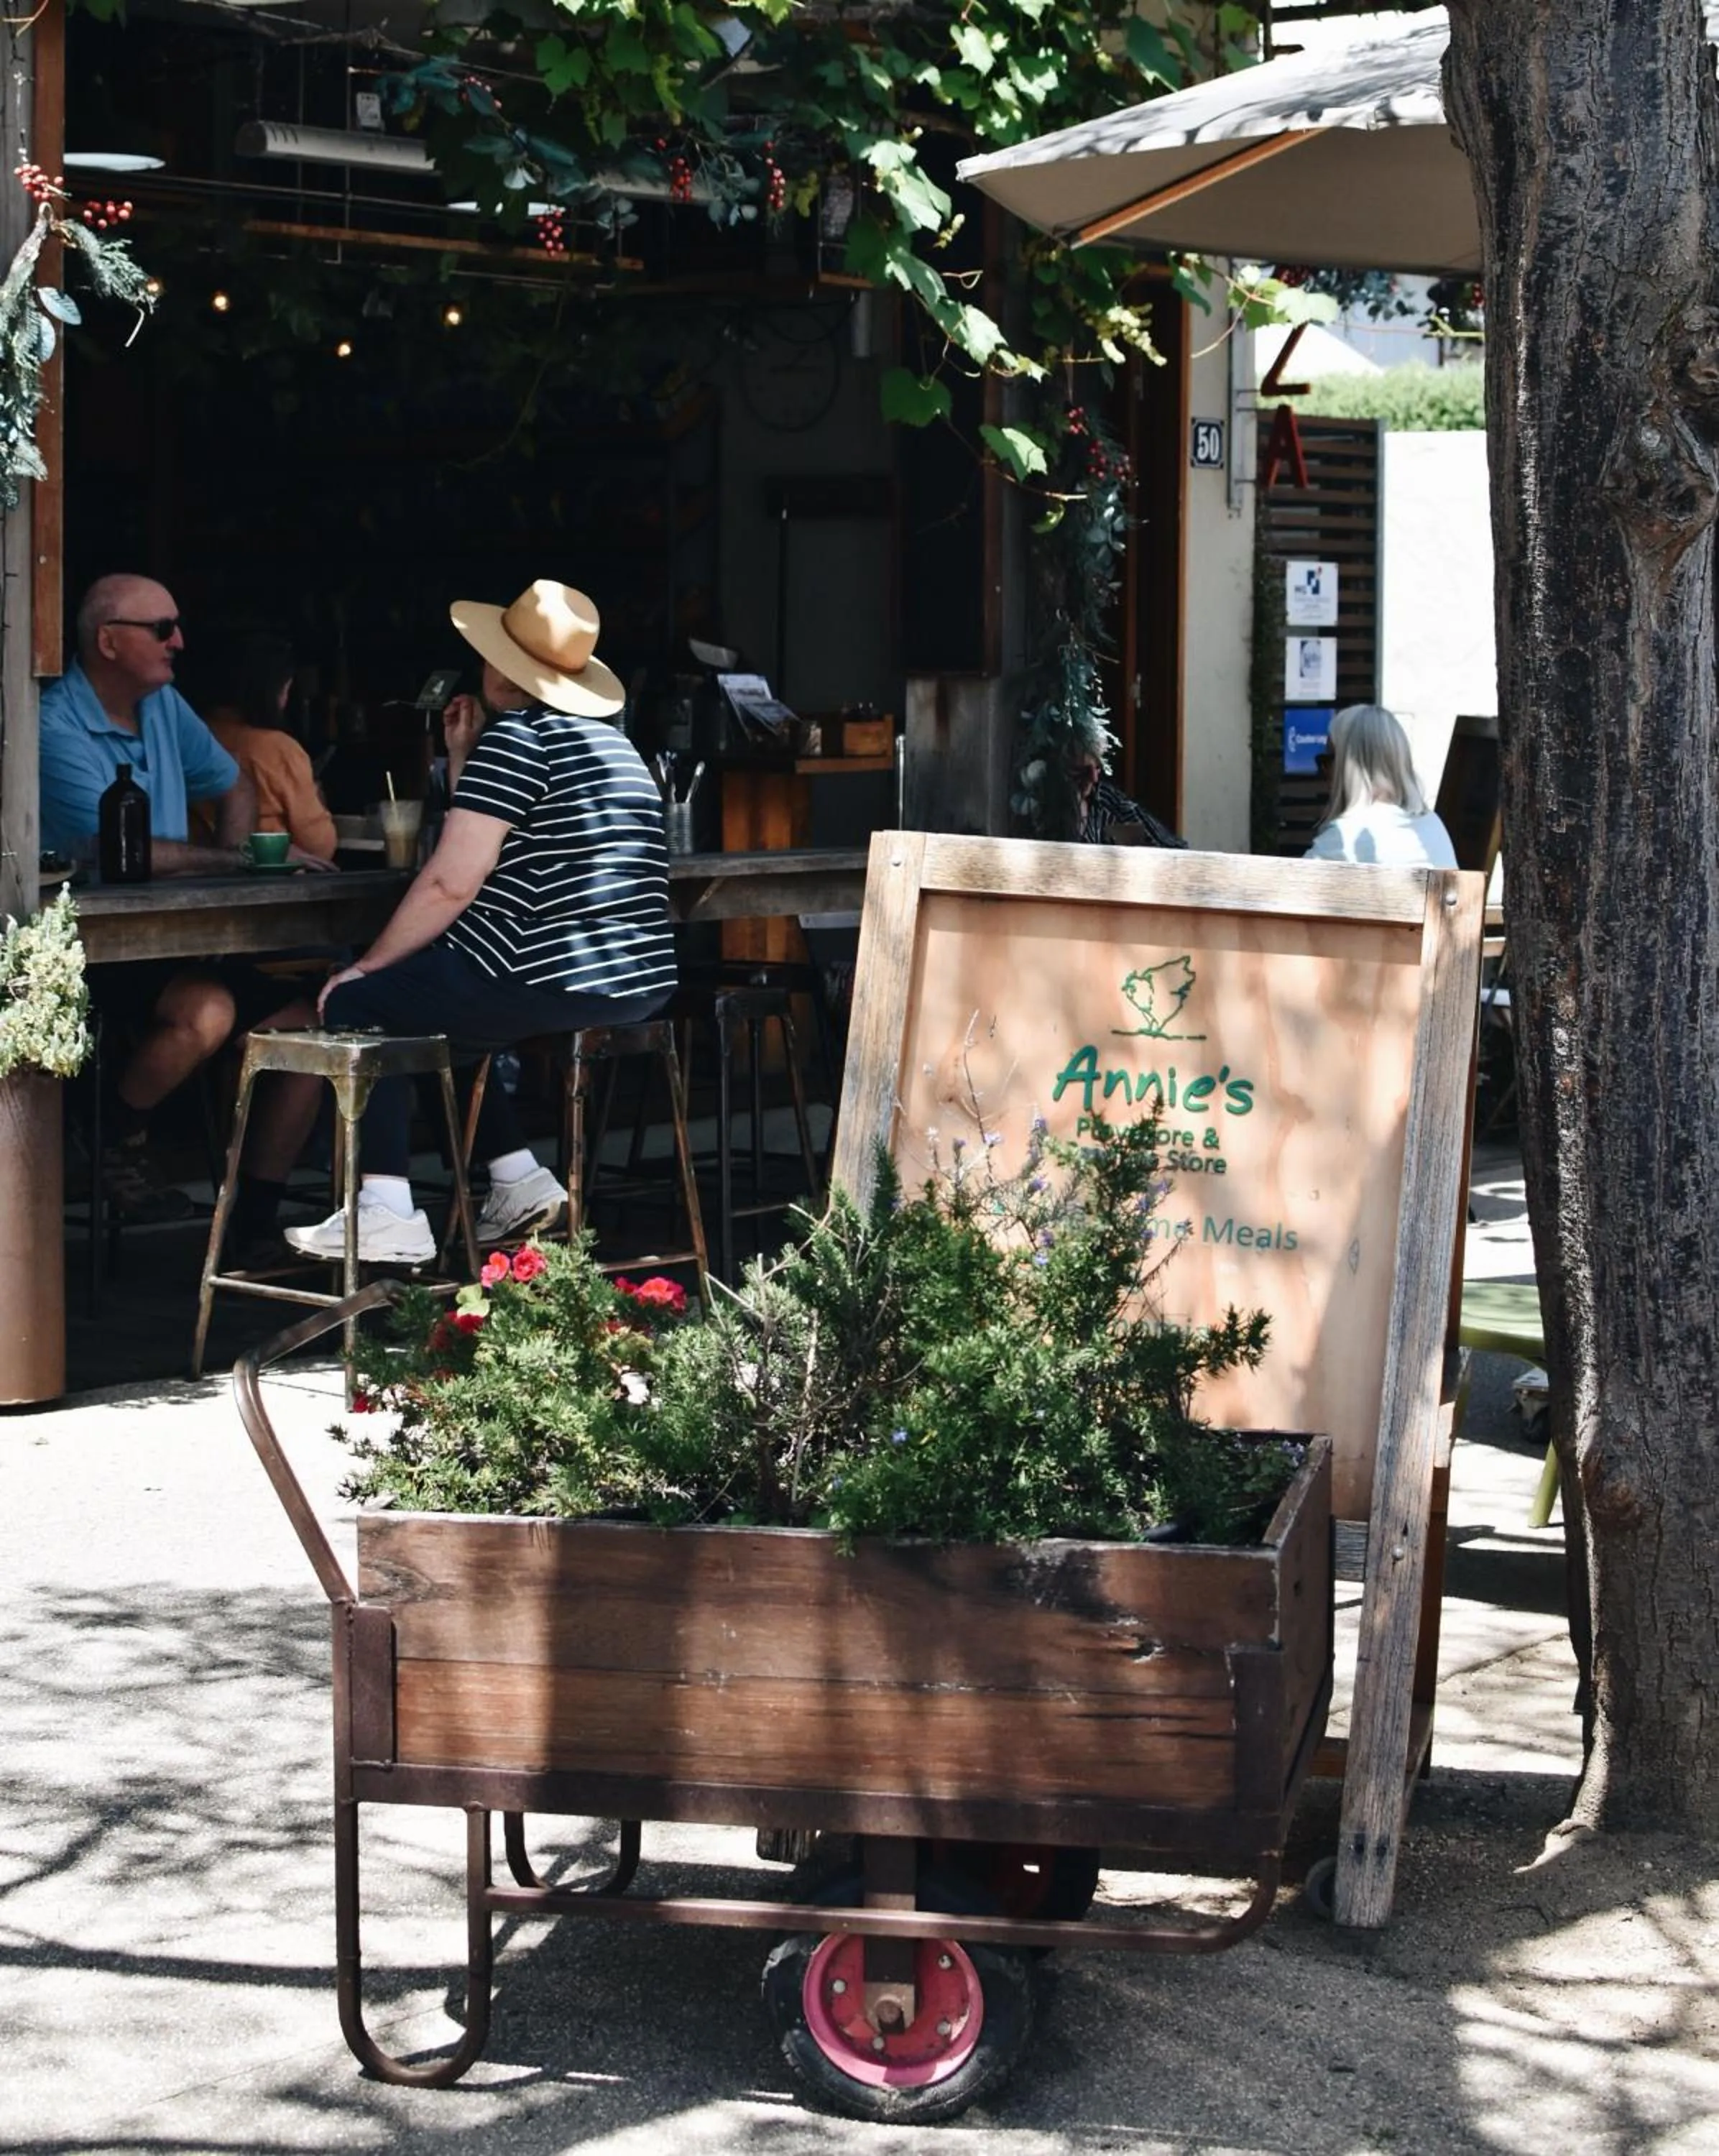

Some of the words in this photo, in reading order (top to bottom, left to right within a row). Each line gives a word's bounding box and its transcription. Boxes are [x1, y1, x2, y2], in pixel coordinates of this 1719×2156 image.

[1197, 425, 1220, 461] 50
[1053, 1045, 1254, 1115] Annie's
[1202, 1127, 1220, 1150] &
[1167, 1150, 1227, 1174] Store
[1202, 1216, 1298, 1250] Meals
